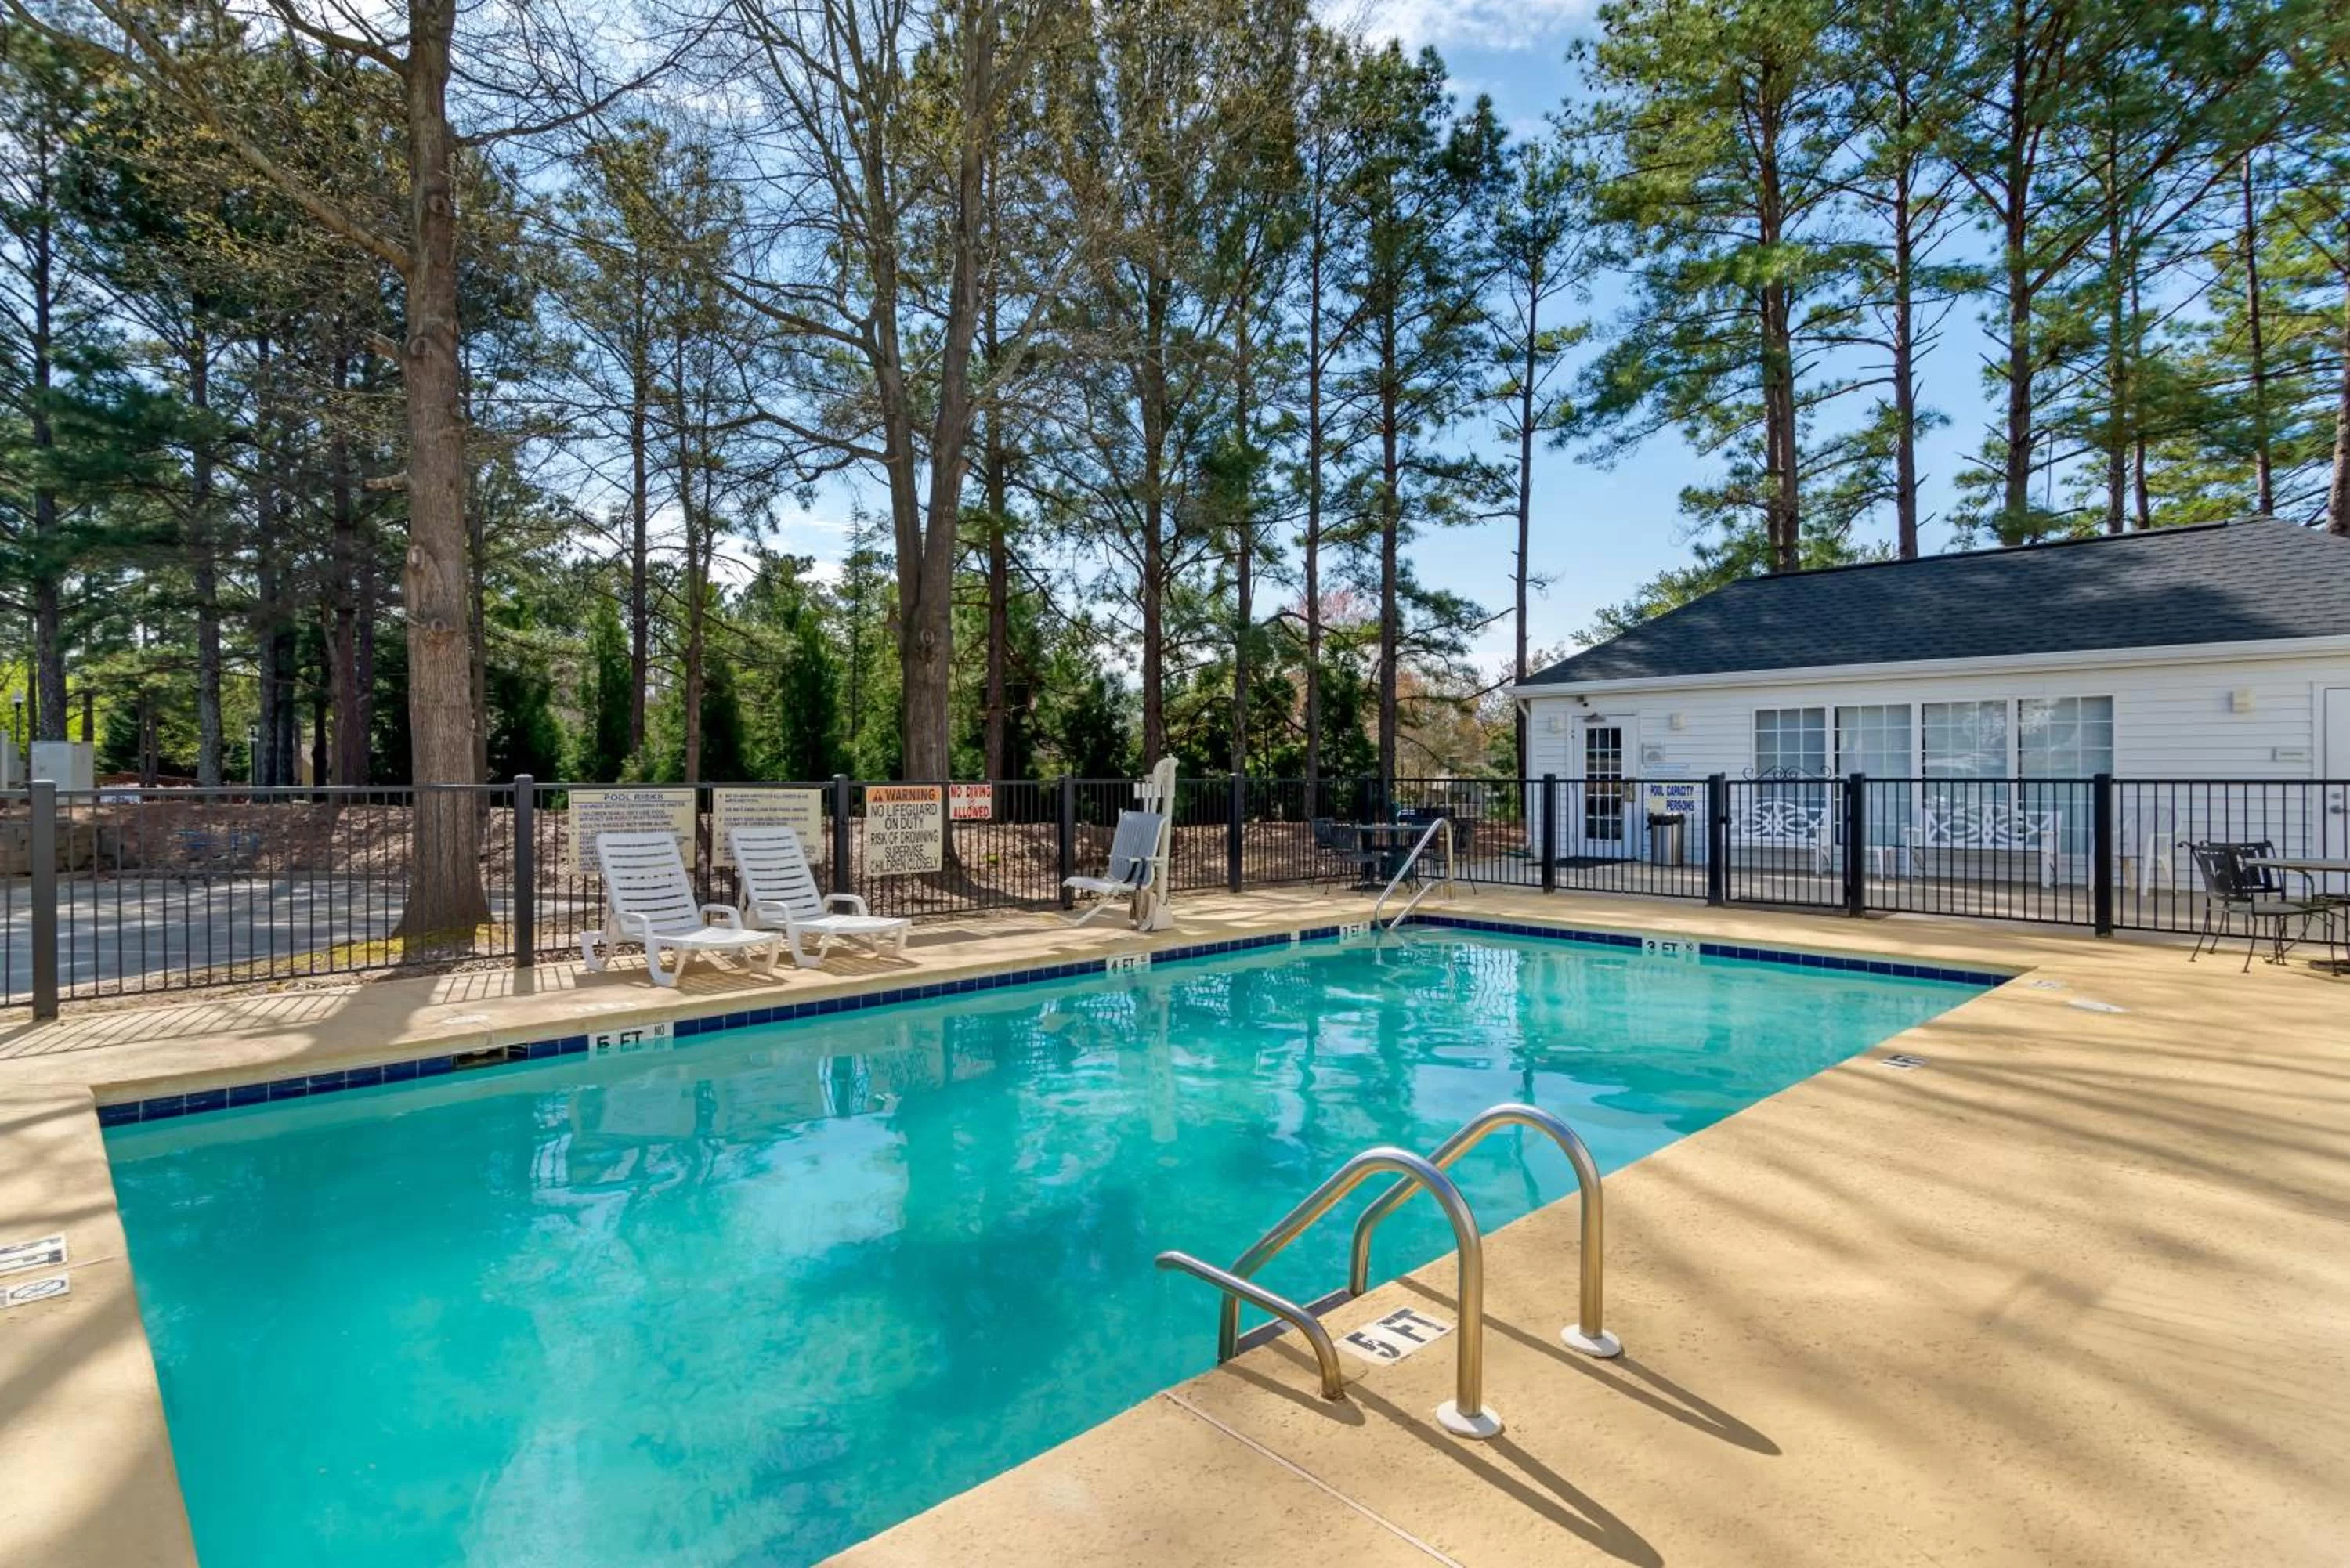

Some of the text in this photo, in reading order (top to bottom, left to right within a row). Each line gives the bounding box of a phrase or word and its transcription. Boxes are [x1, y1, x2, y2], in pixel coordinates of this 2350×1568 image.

[884, 789, 935, 800] WARNING
[950, 786, 991, 797] NO DIVING
[871, 804, 938, 818] NO LIFEGUARD
[953, 806, 989, 818] ALLOWED
[885, 815, 924, 830] ON DUTY
[871, 830, 938, 846] RISK OF DROWNING
[885, 844, 924, 859] SUPERVISE
[870, 855, 939, 873] CHILDREN CLOSELY
[620, 1031, 643, 1046] FT
[1344, 1308, 1447, 1358] 5 FT
